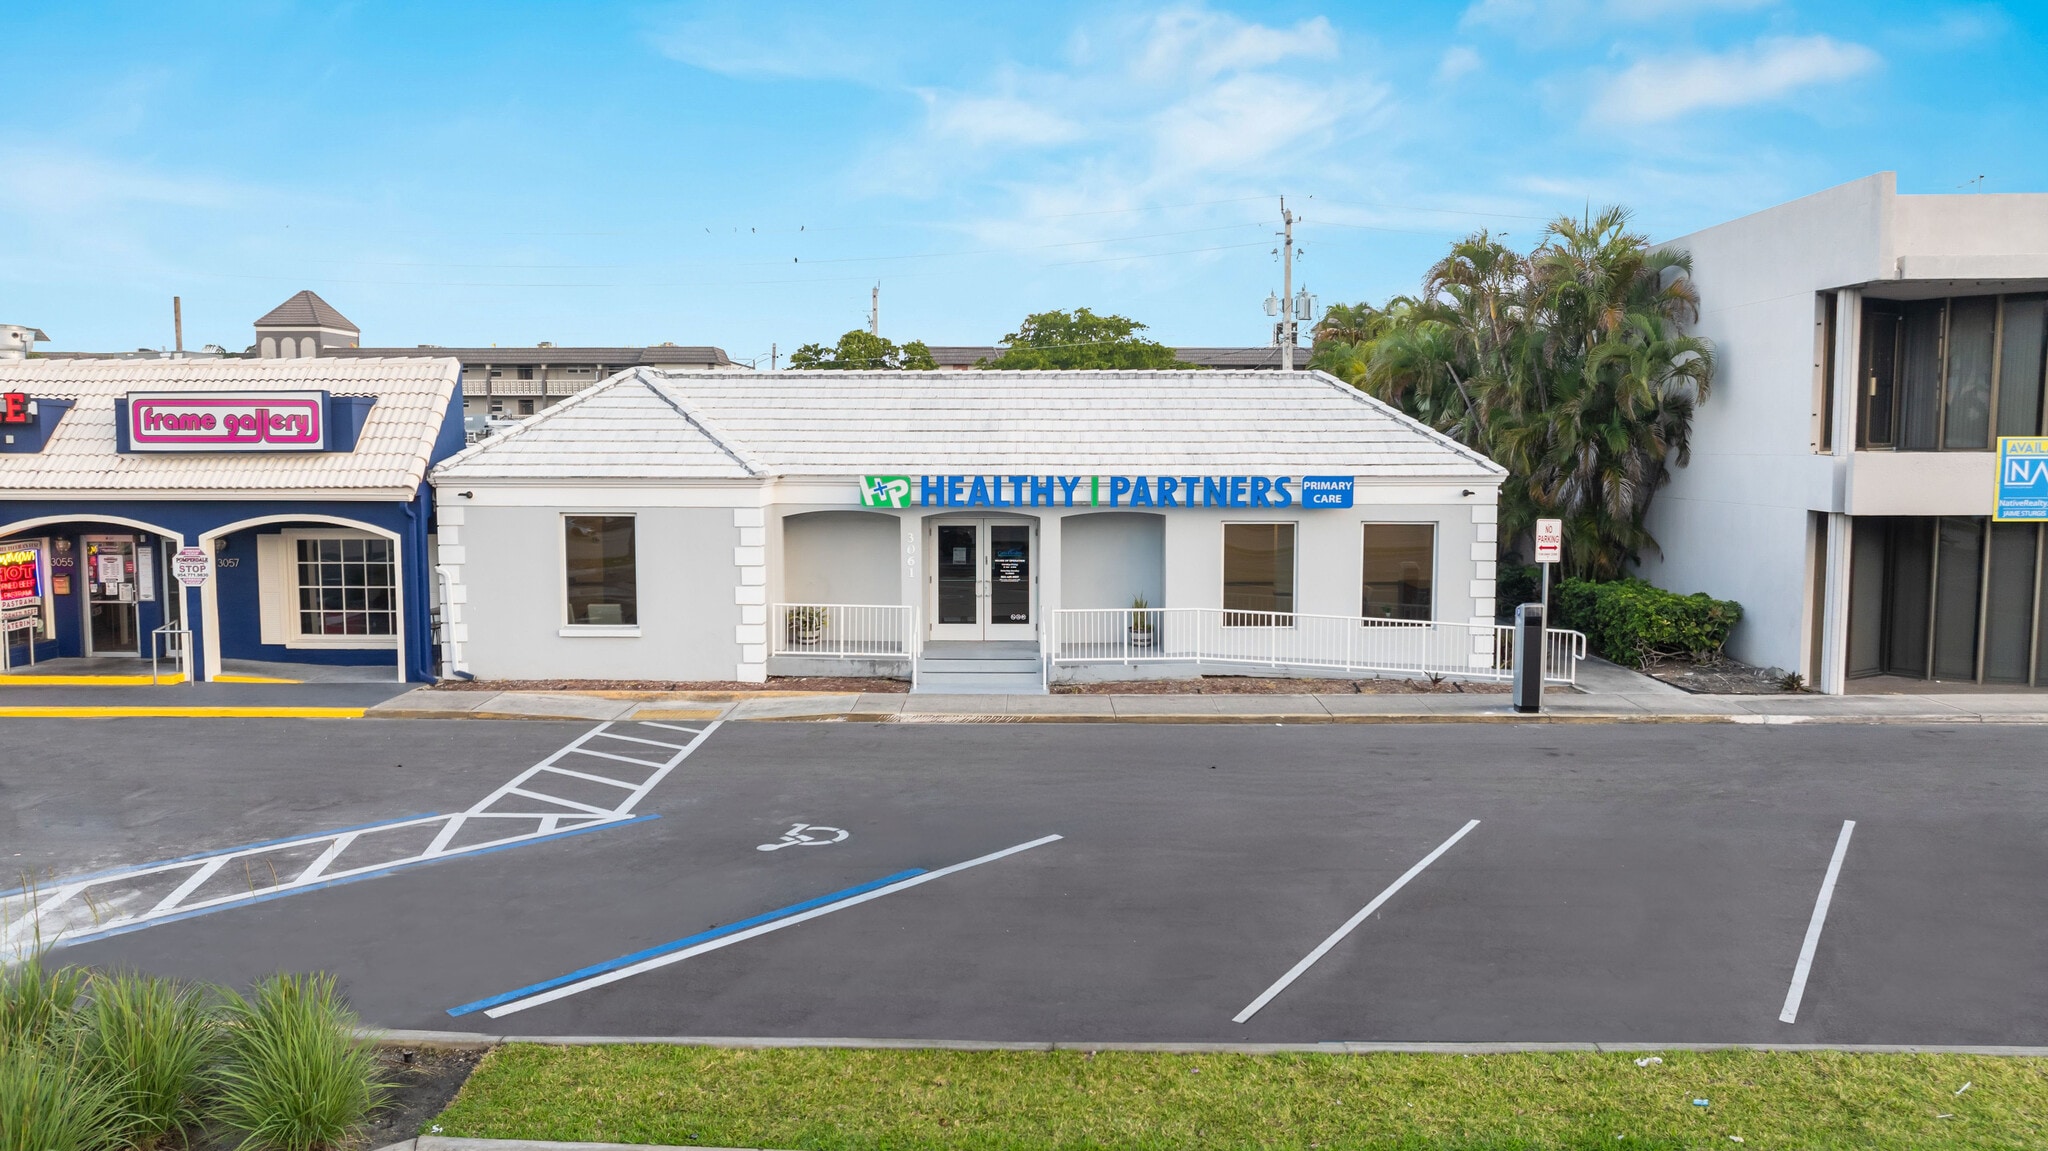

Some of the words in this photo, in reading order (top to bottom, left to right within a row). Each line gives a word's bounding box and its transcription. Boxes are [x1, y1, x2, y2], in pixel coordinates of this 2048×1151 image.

[0, 393, 26, 422] E
[144, 407, 217, 431] frame
[223, 408, 309, 436] gallery
[2010, 442, 2048, 453] AVAIL
[1303, 481, 1352, 491] PRIMARY
[921, 475, 1081, 508] HEALTHY
[1109, 475, 1293, 508] PARTNERS
[1313, 494, 1342, 504] CARE
[1538, 535, 1559, 543] PARKING
[906, 532, 916, 578] 3061
[51, 558, 74, 567] 3055
[217, 558, 240, 568] 3057
[179, 565, 207, 573] STOP
[2, 598, 37, 608] PASTRAMI
